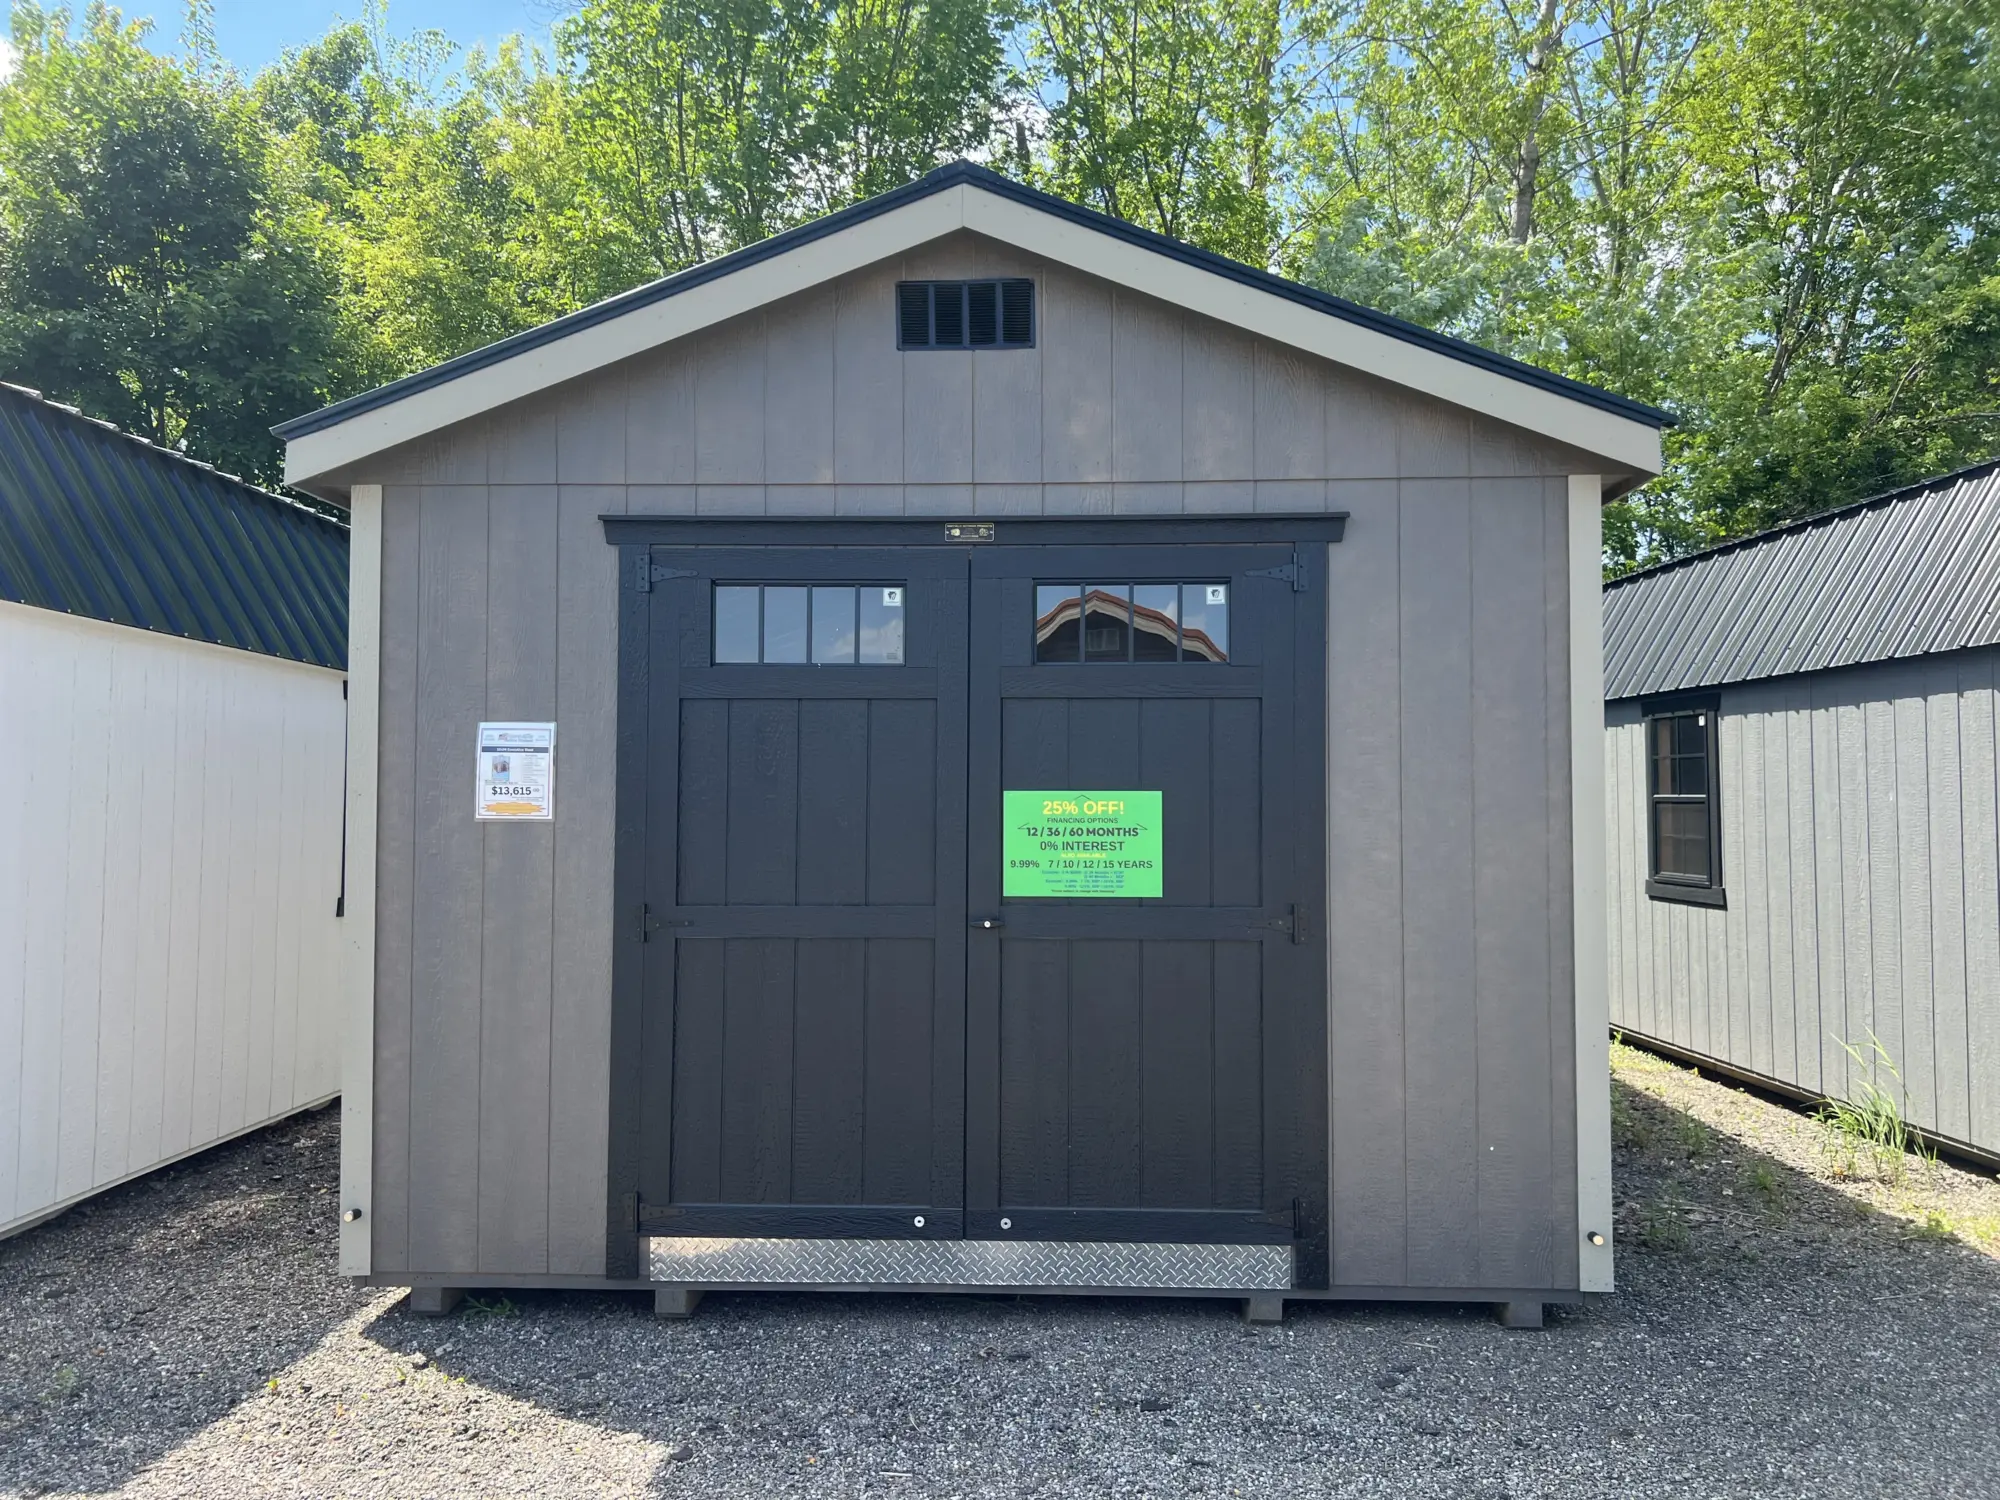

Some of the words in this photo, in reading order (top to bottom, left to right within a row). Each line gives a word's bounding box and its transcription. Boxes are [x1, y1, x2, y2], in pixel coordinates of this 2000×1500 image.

[491, 786, 532, 796] $13,615
[1042, 800, 1078, 815] 25%
[1083, 800, 1125, 815] OFF!
[1026, 827, 1039, 837] 12
[1047, 827, 1060, 837] 36
[1069, 827, 1084, 837] 60
[1086, 827, 1139, 837] MONTHS
[1040, 841, 1058, 851] 0%
[1062, 841, 1125, 851] INTEREST
[1010, 860, 1040, 868] 9.99%
[1048, 860, 1054, 868] 7
[1063, 860, 1074, 868] 10
[1083, 860, 1095, 868] 12
[1103, 860, 1115, 868] 15
[1117, 860, 1153, 868] YEARS
